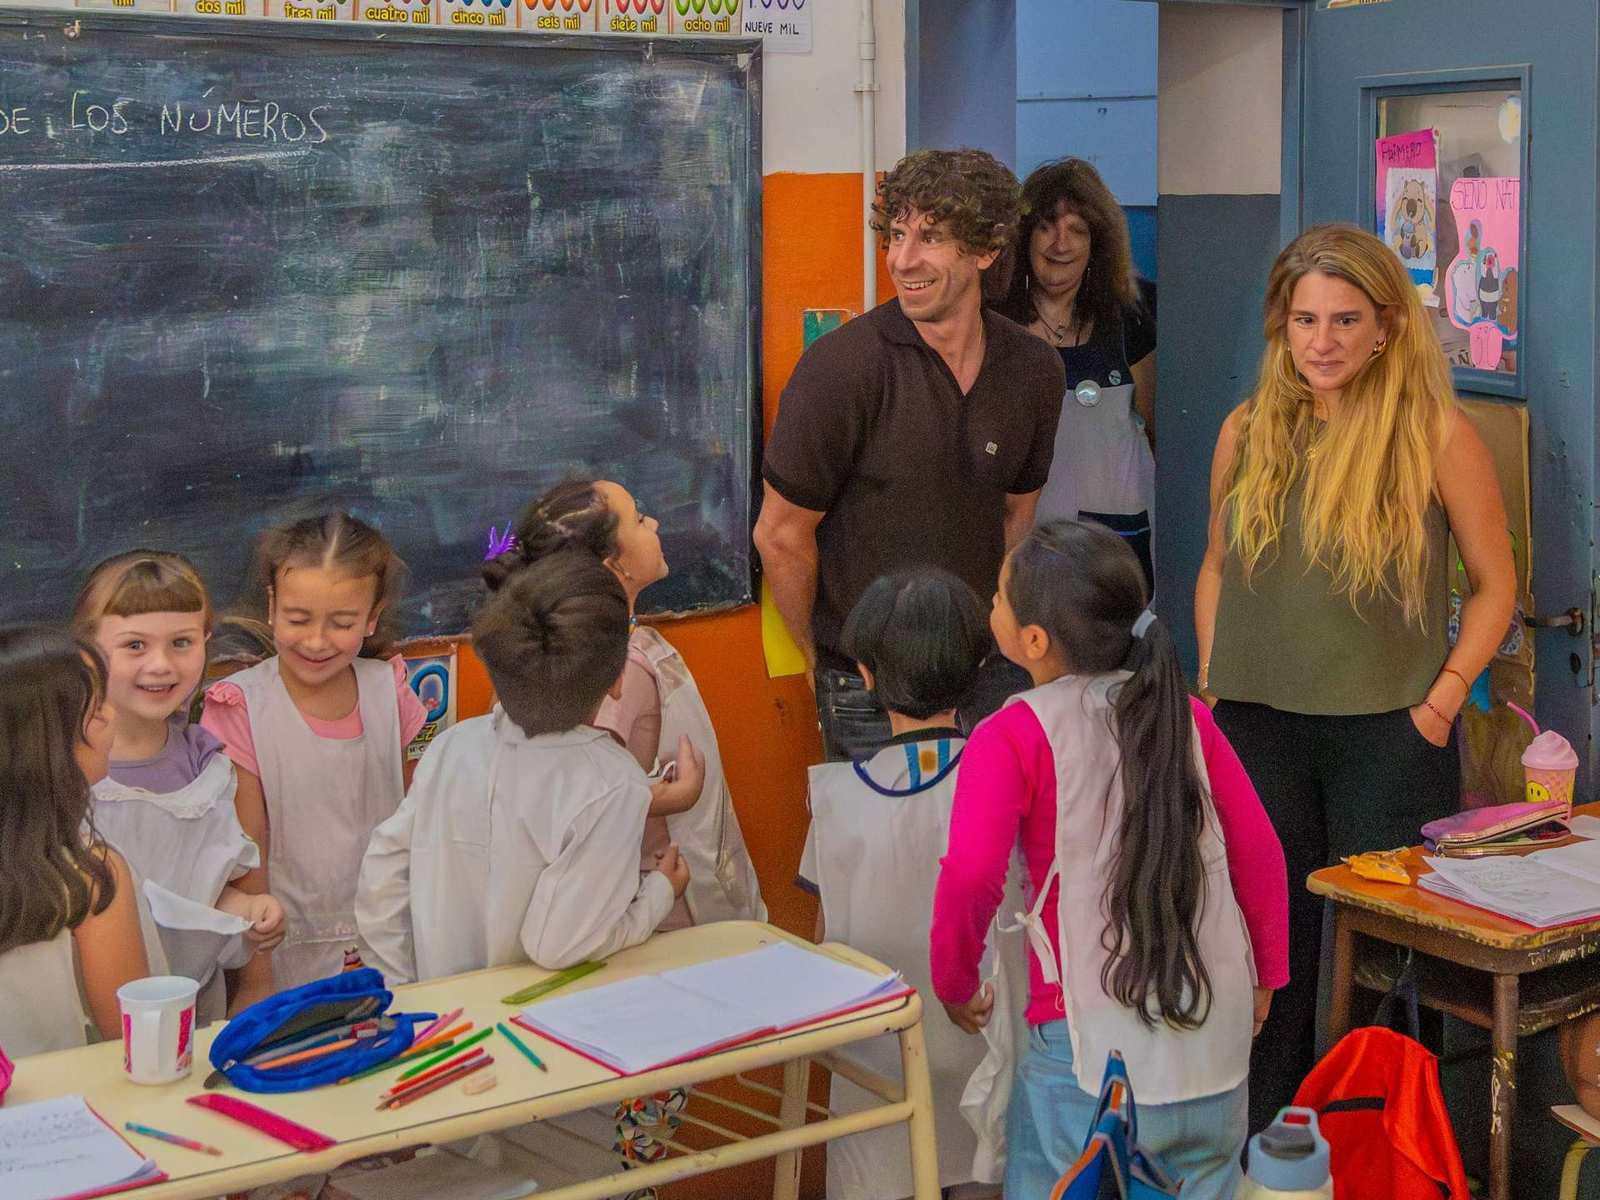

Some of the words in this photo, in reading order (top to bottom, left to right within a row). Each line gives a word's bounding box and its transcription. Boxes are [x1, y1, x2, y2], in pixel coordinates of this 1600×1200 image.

[195, 0, 221, 13] dos
[225, 0, 246, 16] mil
[284, 4, 312, 20] tres
[317, 5, 336, 21] mil
[365, 5, 408, 22] cuatro
[412, 7, 430, 24] mil
[452, 9, 484, 24] cinco
[489, 9, 506, 25] mil
[537, 13, 560, 29] seis
[564, 13, 581, 30] mil
[610, 15, 637, 32] siete
[641, 15, 657, 33] mil
[684, 16, 711, 32] ocho
[715, 17, 731, 33] mil
[744, 21, 774, 34] NUEVE
[71, 90, 132, 135] LOS
[160, 86, 329, 144] NÚMEROS
